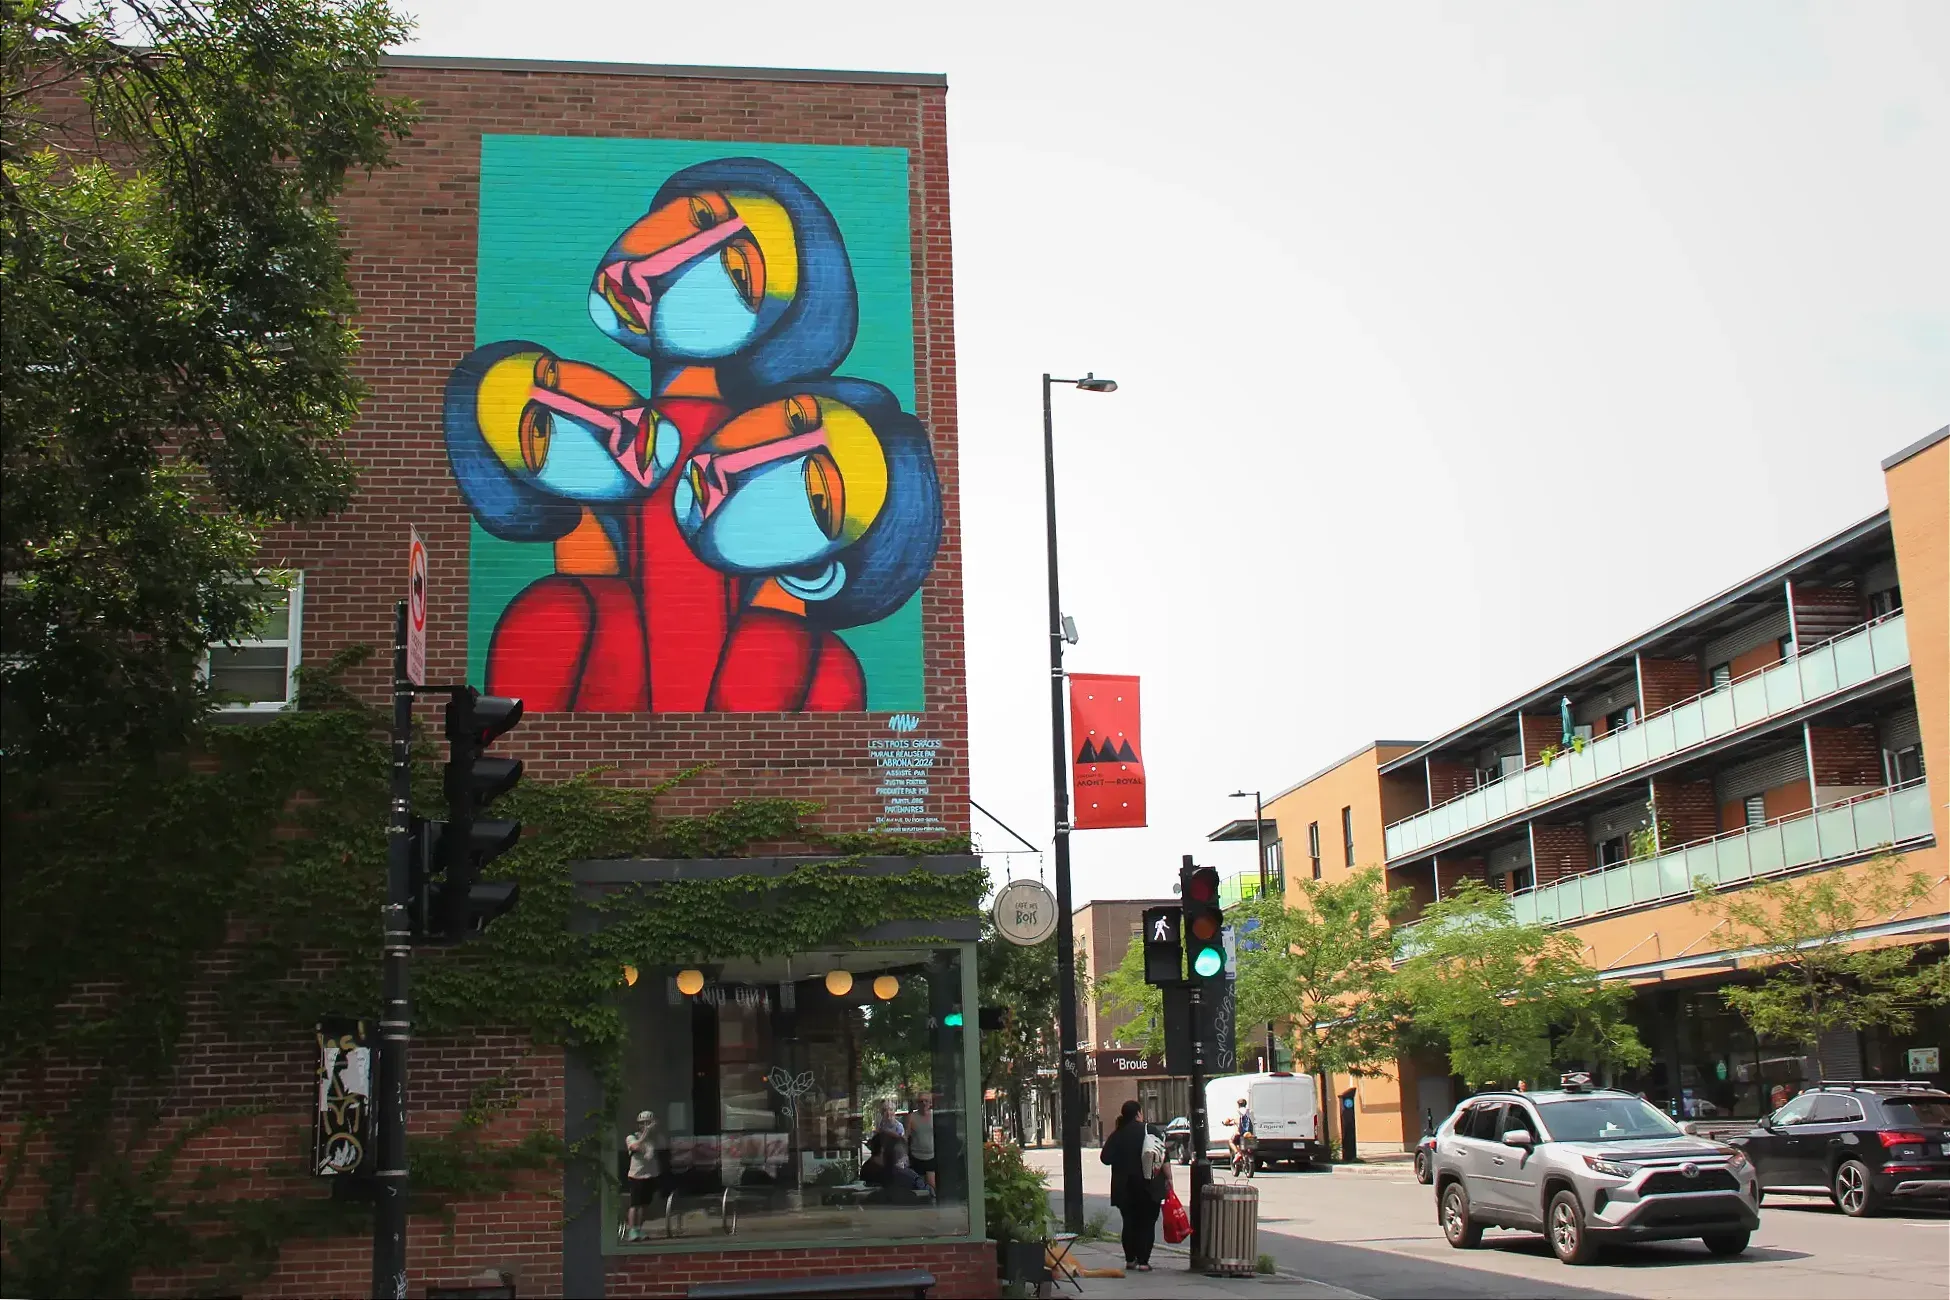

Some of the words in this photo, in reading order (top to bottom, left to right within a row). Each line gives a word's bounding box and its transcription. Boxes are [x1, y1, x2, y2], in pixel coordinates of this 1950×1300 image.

[867, 740, 883, 749] LES
[885, 740, 909, 749] TROIS
[1016, 910, 1037, 924] BOIS
[1119, 1058, 1148, 1070] Broue
